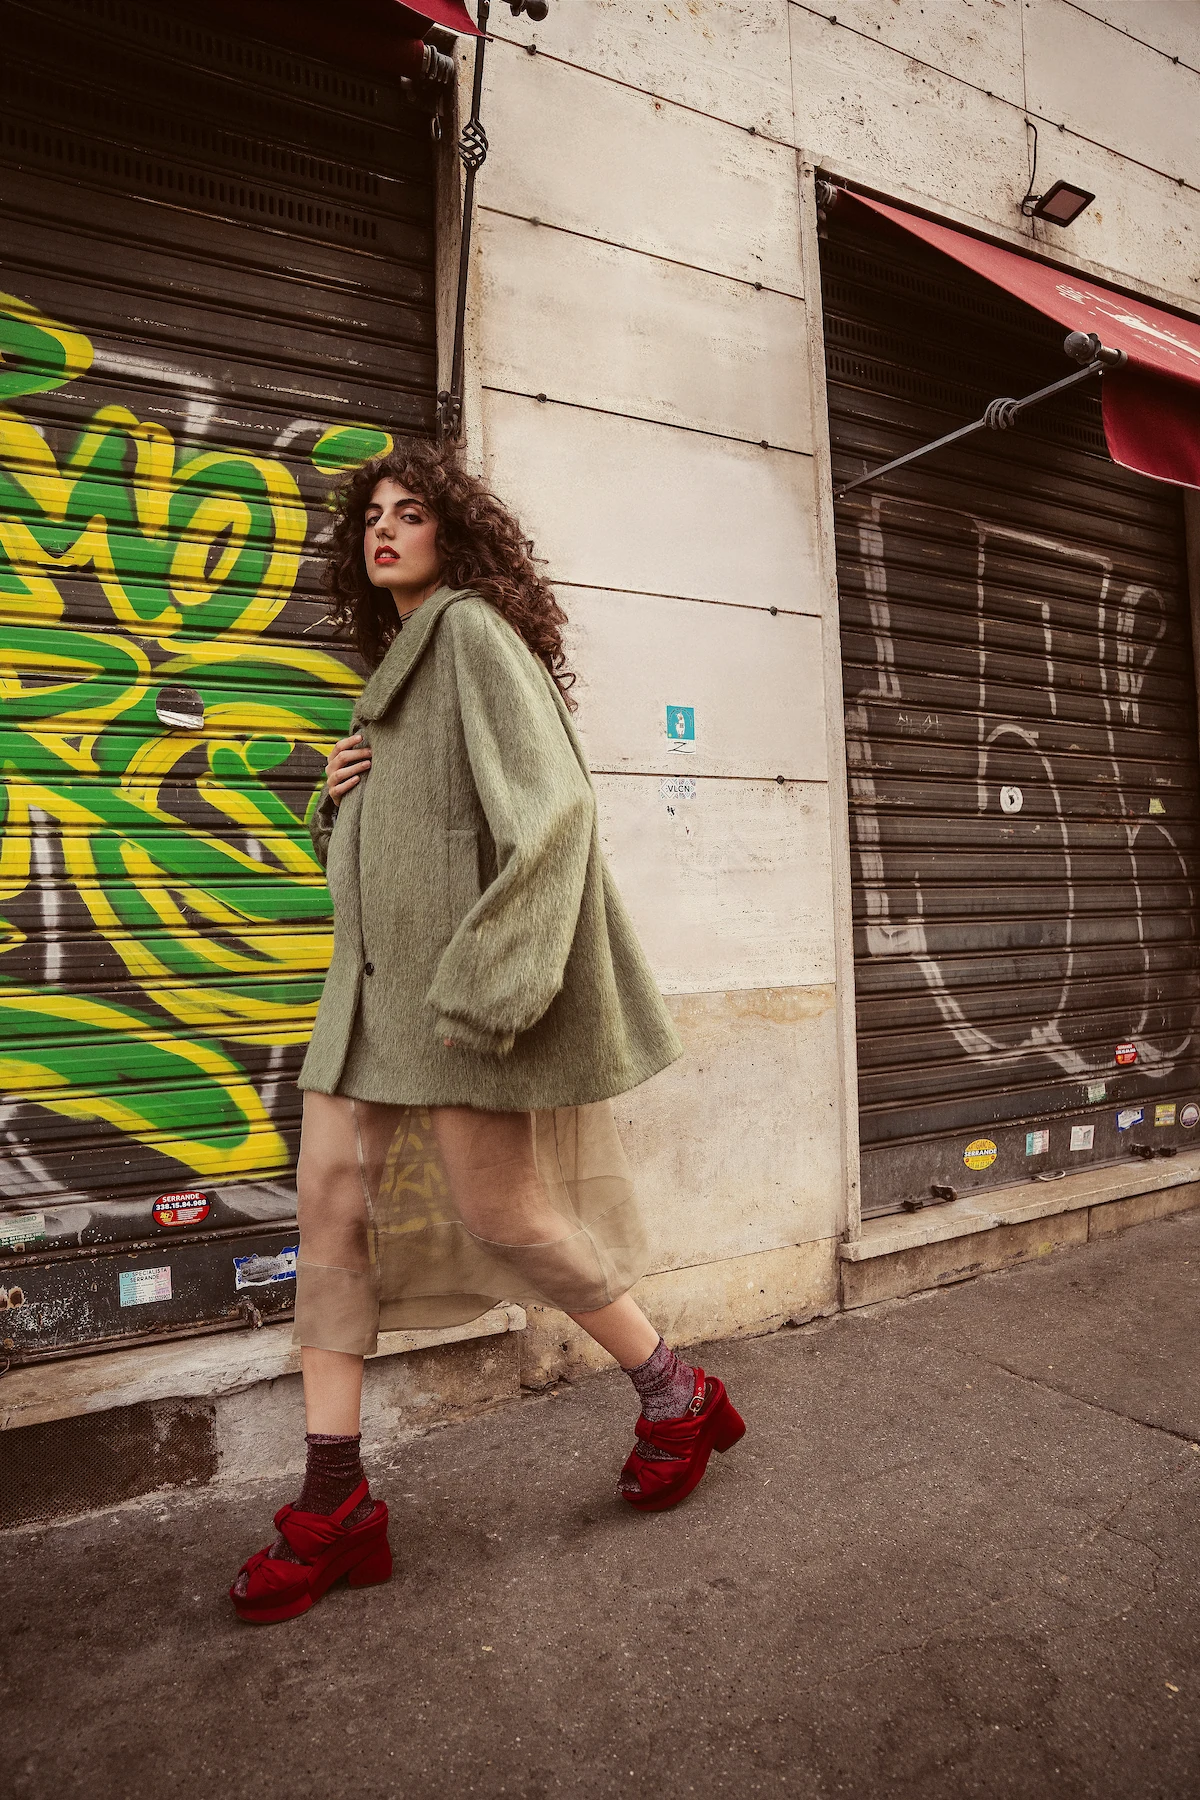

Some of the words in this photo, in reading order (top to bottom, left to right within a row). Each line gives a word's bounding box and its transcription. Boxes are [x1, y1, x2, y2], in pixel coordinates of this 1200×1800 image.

[667, 785, 690, 793] VLCN
[963, 1148, 997, 1158] SERRANDE
[162, 1192, 200, 1203] SERRANDE
[155, 1199, 207, 1211] 338.15.84.968
[131, 1268, 168, 1278] SPECIALISTA
[130, 1274, 160, 1284] SERRANDE
